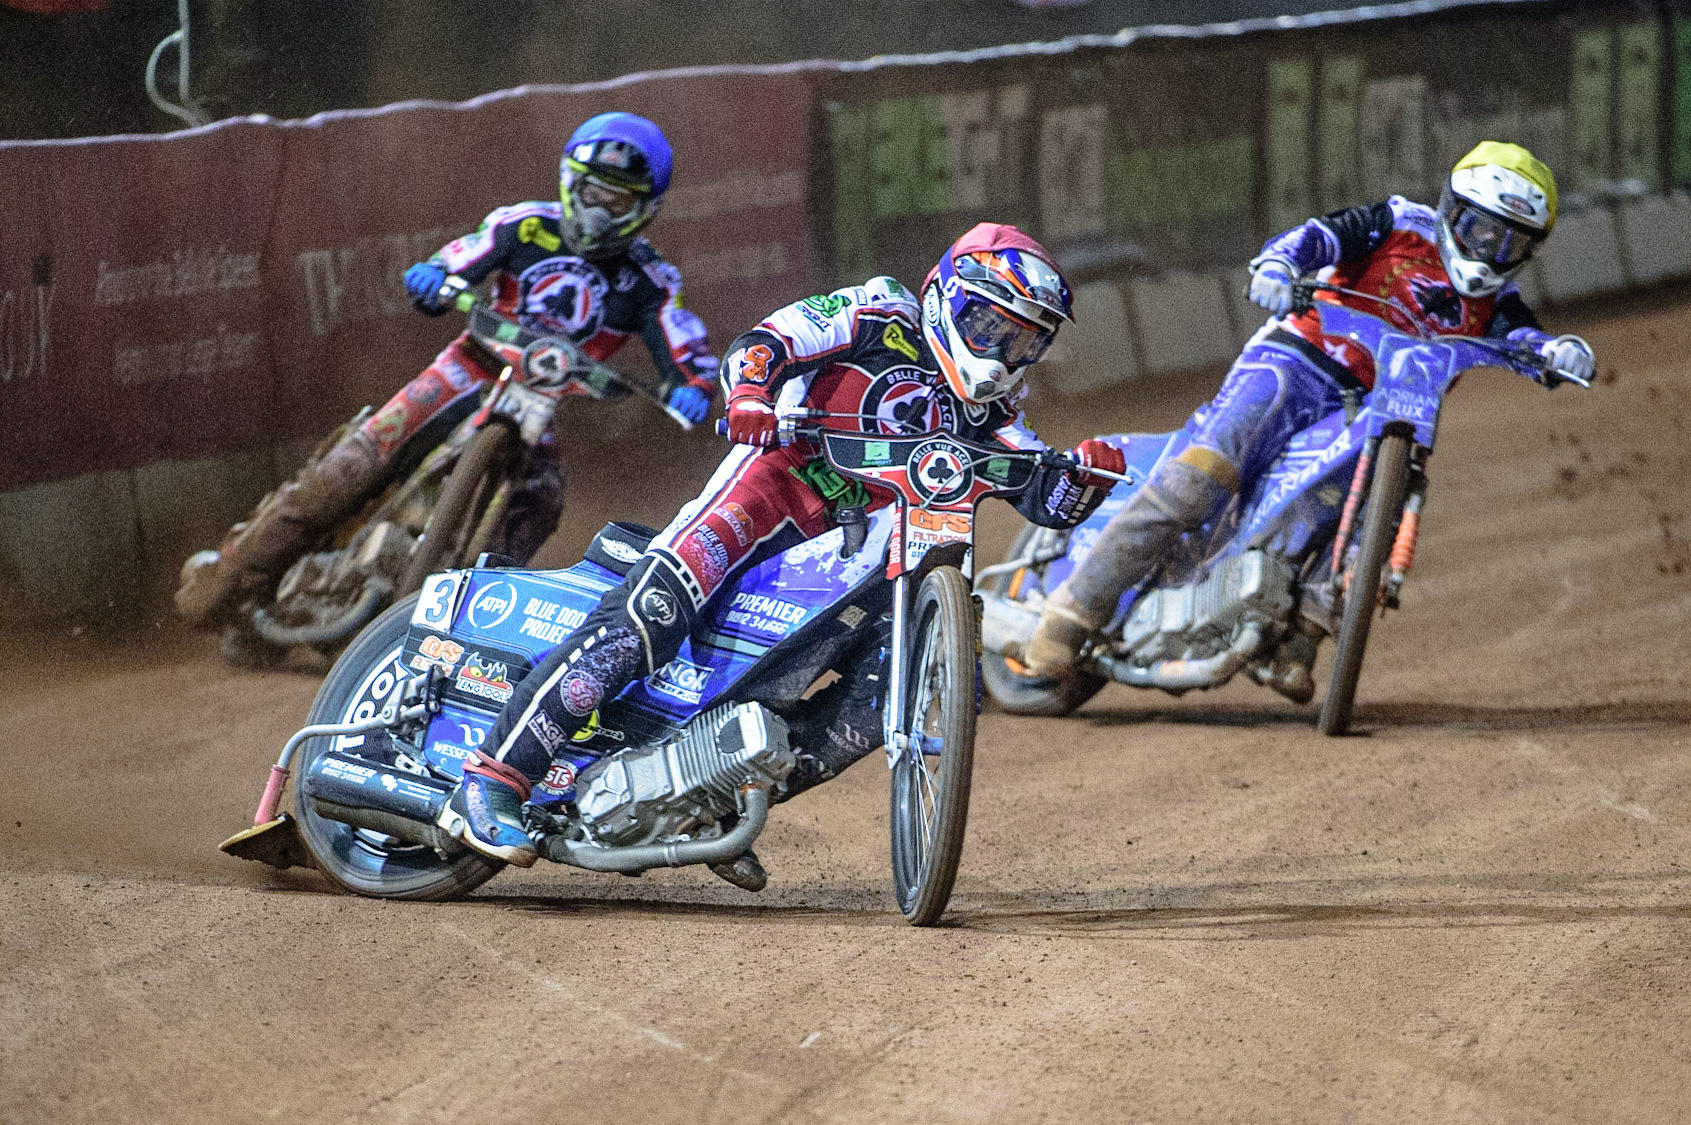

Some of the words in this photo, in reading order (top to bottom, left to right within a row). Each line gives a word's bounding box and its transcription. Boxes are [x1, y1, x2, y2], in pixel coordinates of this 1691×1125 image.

[886, 371, 921, 385] BELLE
[940, 404, 951, 430] ACE
[1375, 387, 1440, 409] ADRIAN
[1386, 401, 1426, 419] FLUX
[912, 443, 934, 464] BELLE
[935, 442, 953, 451] VUE
[953, 449, 970, 470] ACE
[692, 531, 721, 567] PROJECT
[696, 524, 720, 543] BLUE
[714, 542, 729, 568] DOOR
[888, 535, 902, 563] DOOR
[425, 578, 456, 623] 3
[476, 596, 509, 615] ATPI
[523, 597, 560, 622] BLUE
[555, 606, 588, 630] DOO
[649, 593, 673, 619] ATPI
[730, 592, 808, 625] PREMIER
[659, 661, 709, 691] NGK
[536, 713, 567, 750] NGK
[432, 741, 472, 760] WESSE
[321, 757, 378, 778] PREMIER
[543, 766, 571, 786] STS
